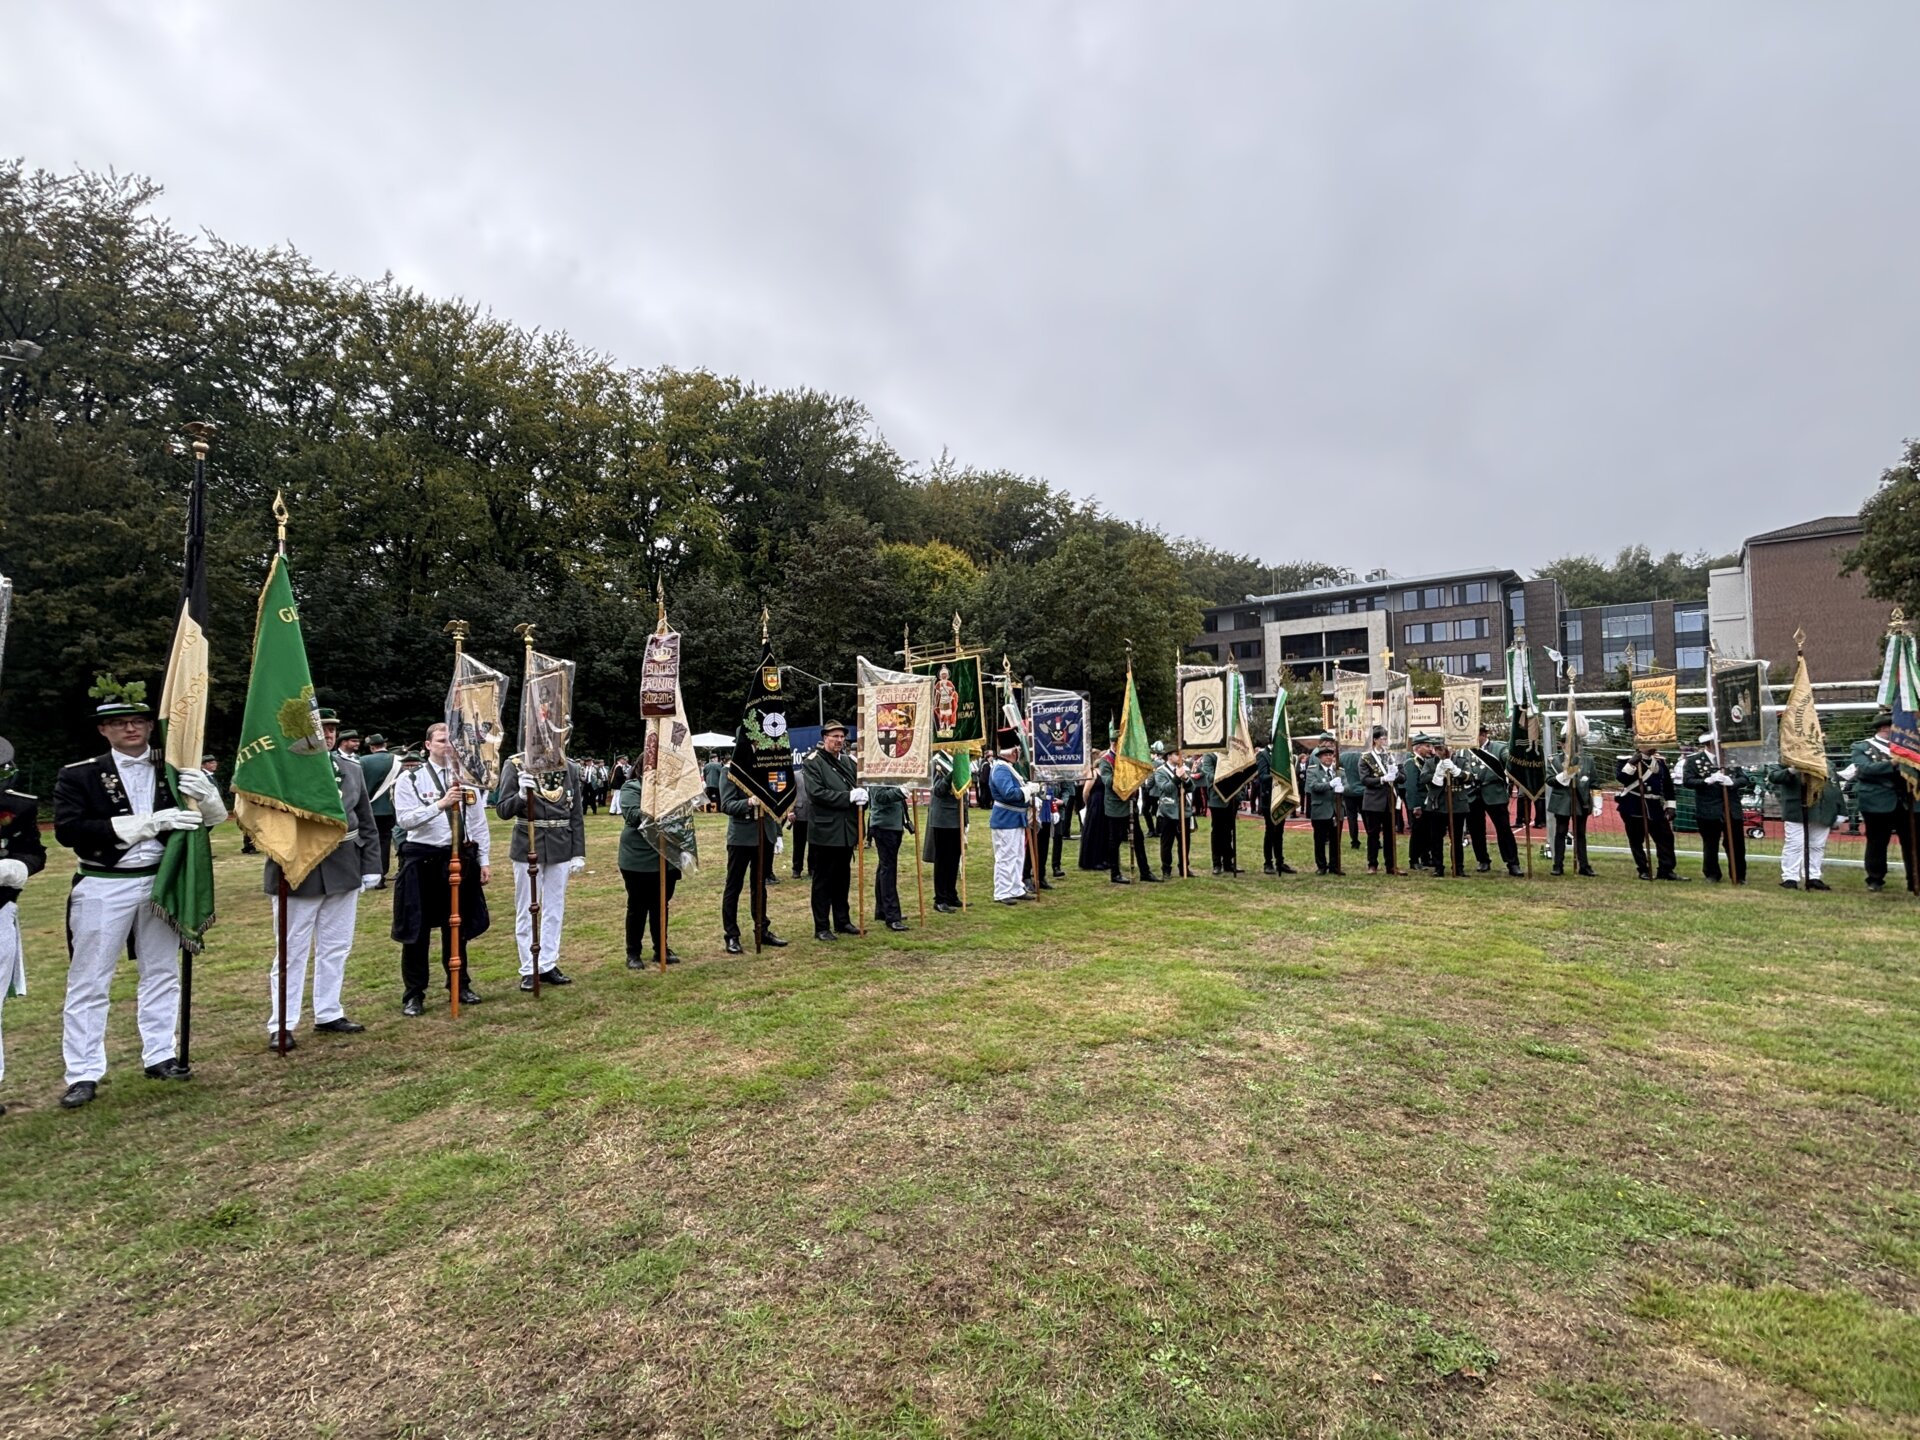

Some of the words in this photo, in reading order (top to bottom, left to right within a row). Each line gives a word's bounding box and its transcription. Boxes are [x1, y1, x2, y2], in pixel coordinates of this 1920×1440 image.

[646, 663, 676, 675] BUNDES
[1037, 704, 1079, 714] Pionierzug
[1039, 754, 1081, 762] ALDENHOVEN
